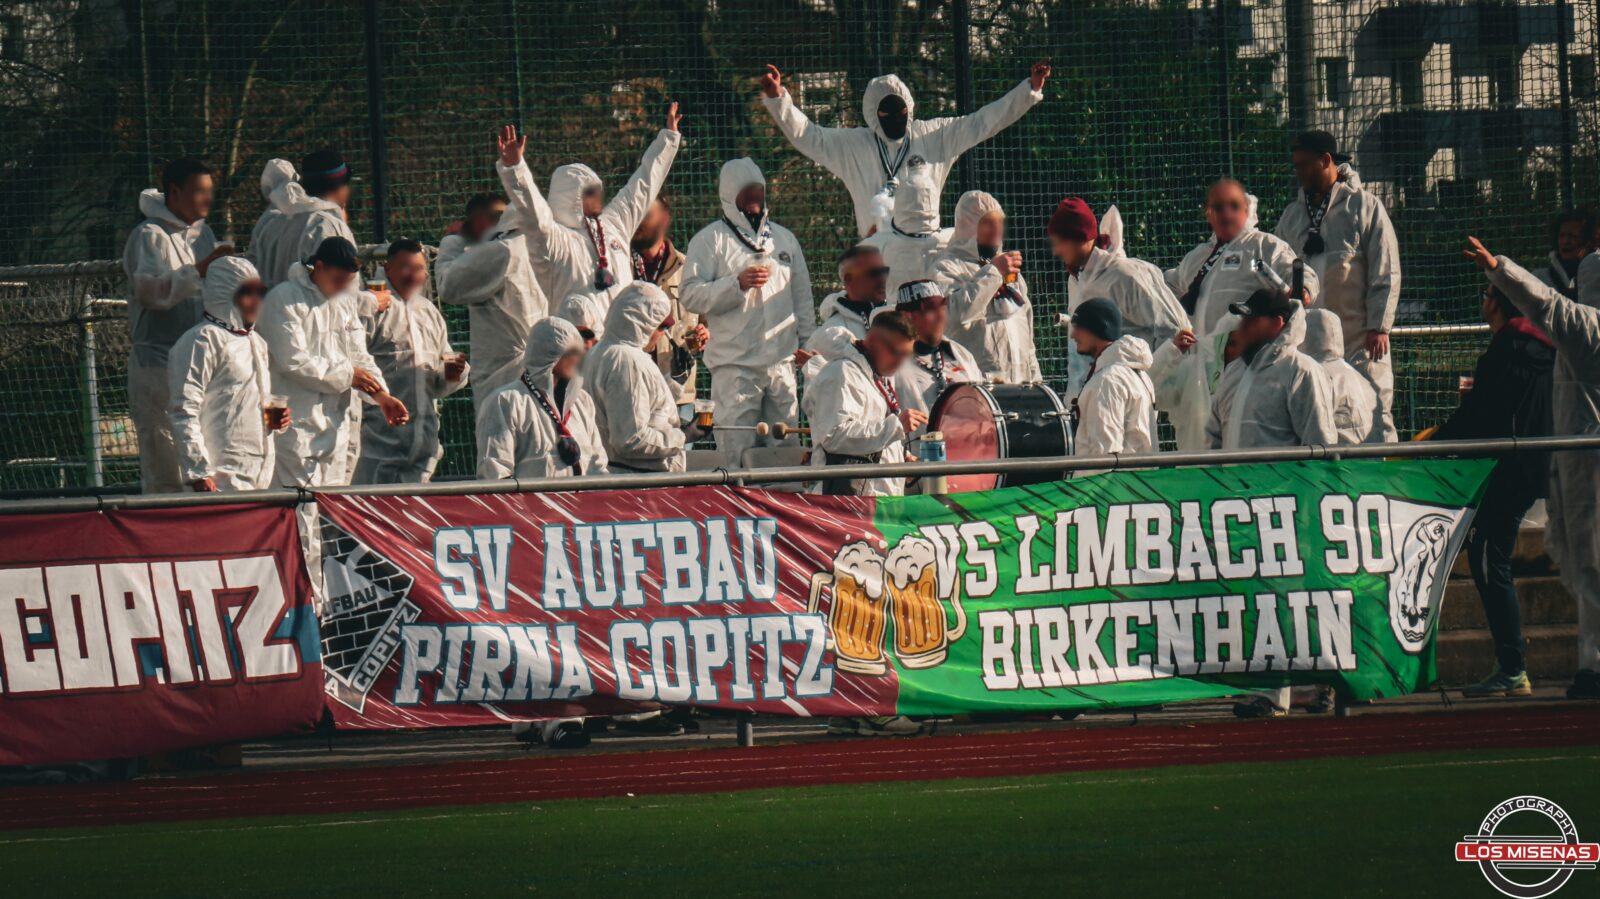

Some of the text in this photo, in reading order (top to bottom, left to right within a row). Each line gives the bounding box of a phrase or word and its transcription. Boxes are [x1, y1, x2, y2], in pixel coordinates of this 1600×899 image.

[434, 517, 778, 611] SV AUFBAU
[919, 494, 1397, 599] VS LIMBACH 90
[0, 556, 299, 692] COPITZ
[352, 606, 416, 692] COPITZ
[394, 612, 836, 704] PIRNA COPITZ
[978, 590, 1357, 691] BIRKENHAIN
